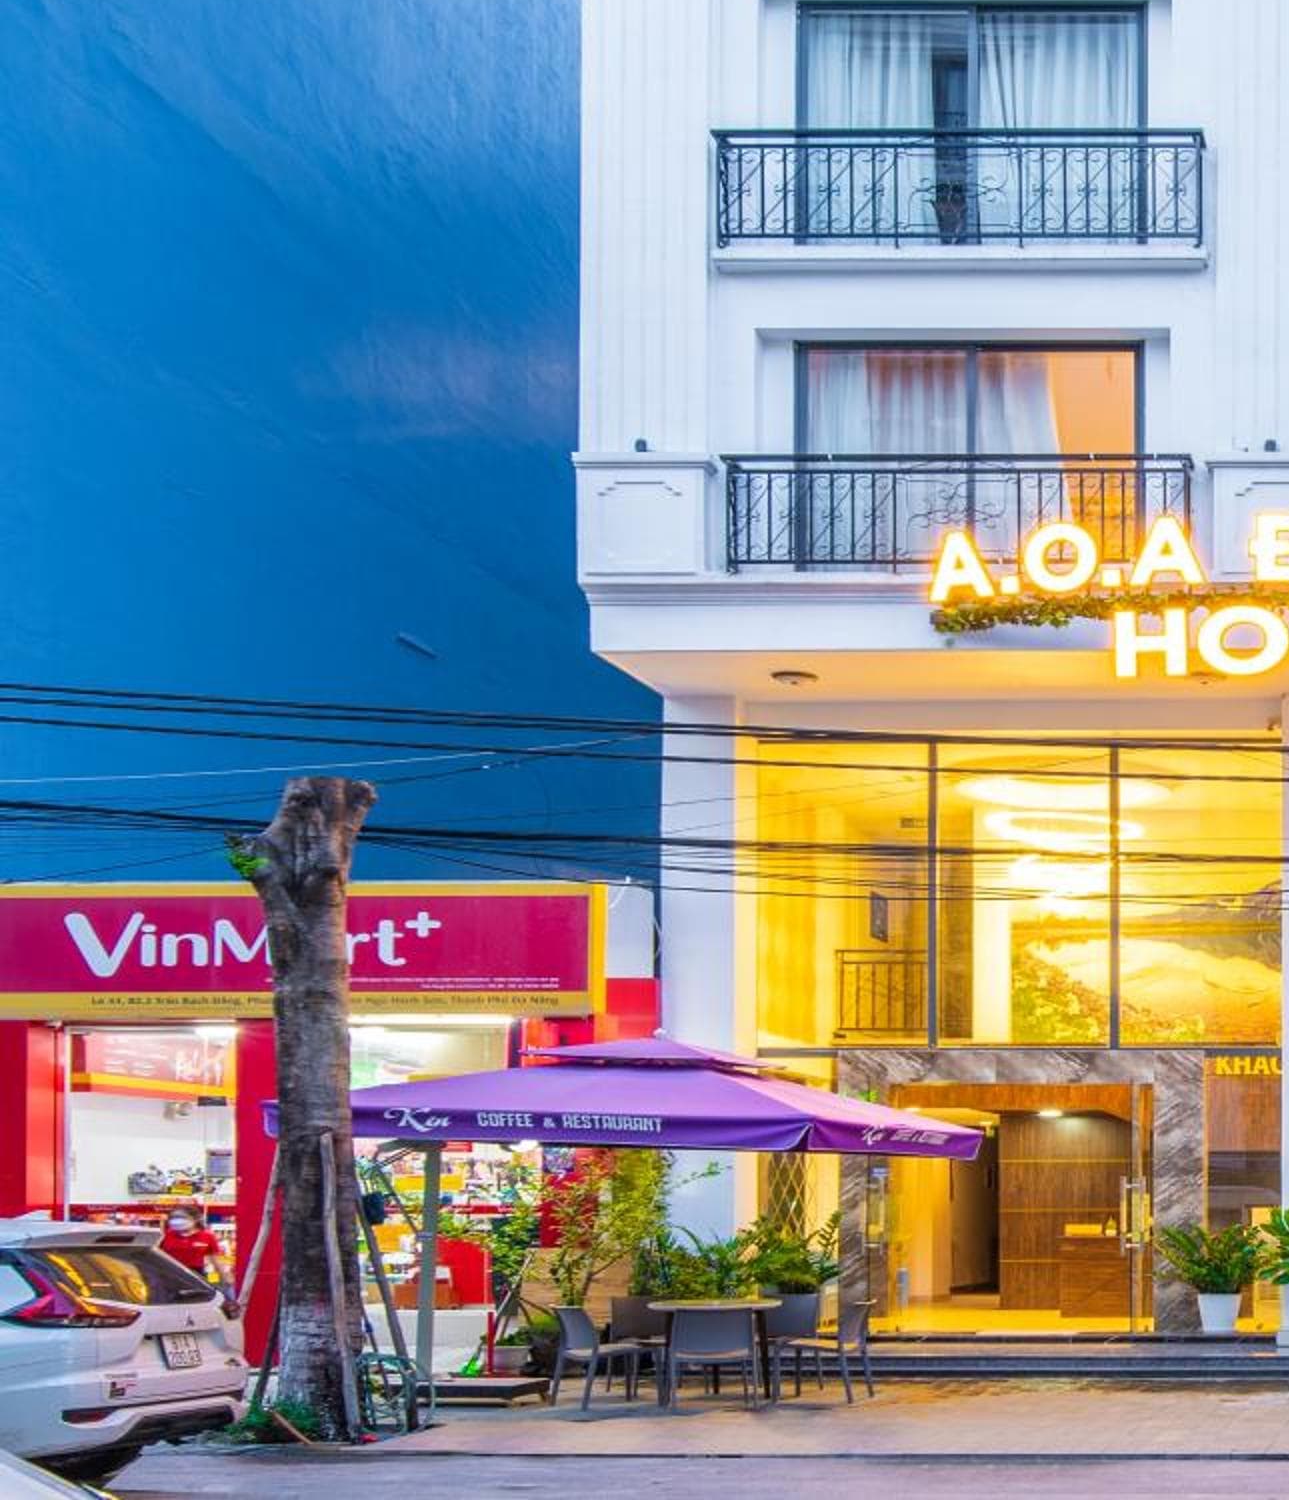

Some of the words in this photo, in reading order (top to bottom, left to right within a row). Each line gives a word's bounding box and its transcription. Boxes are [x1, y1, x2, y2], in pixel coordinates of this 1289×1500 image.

[929, 513, 1203, 602] A.O.A
[64, 911, 441, 978] VinMrt+
[477, 1111, 533, 1128] COFFEE
[543, 1116, 555, 1129] &
[562, 1112, 661, 1134] RESTAURANT
